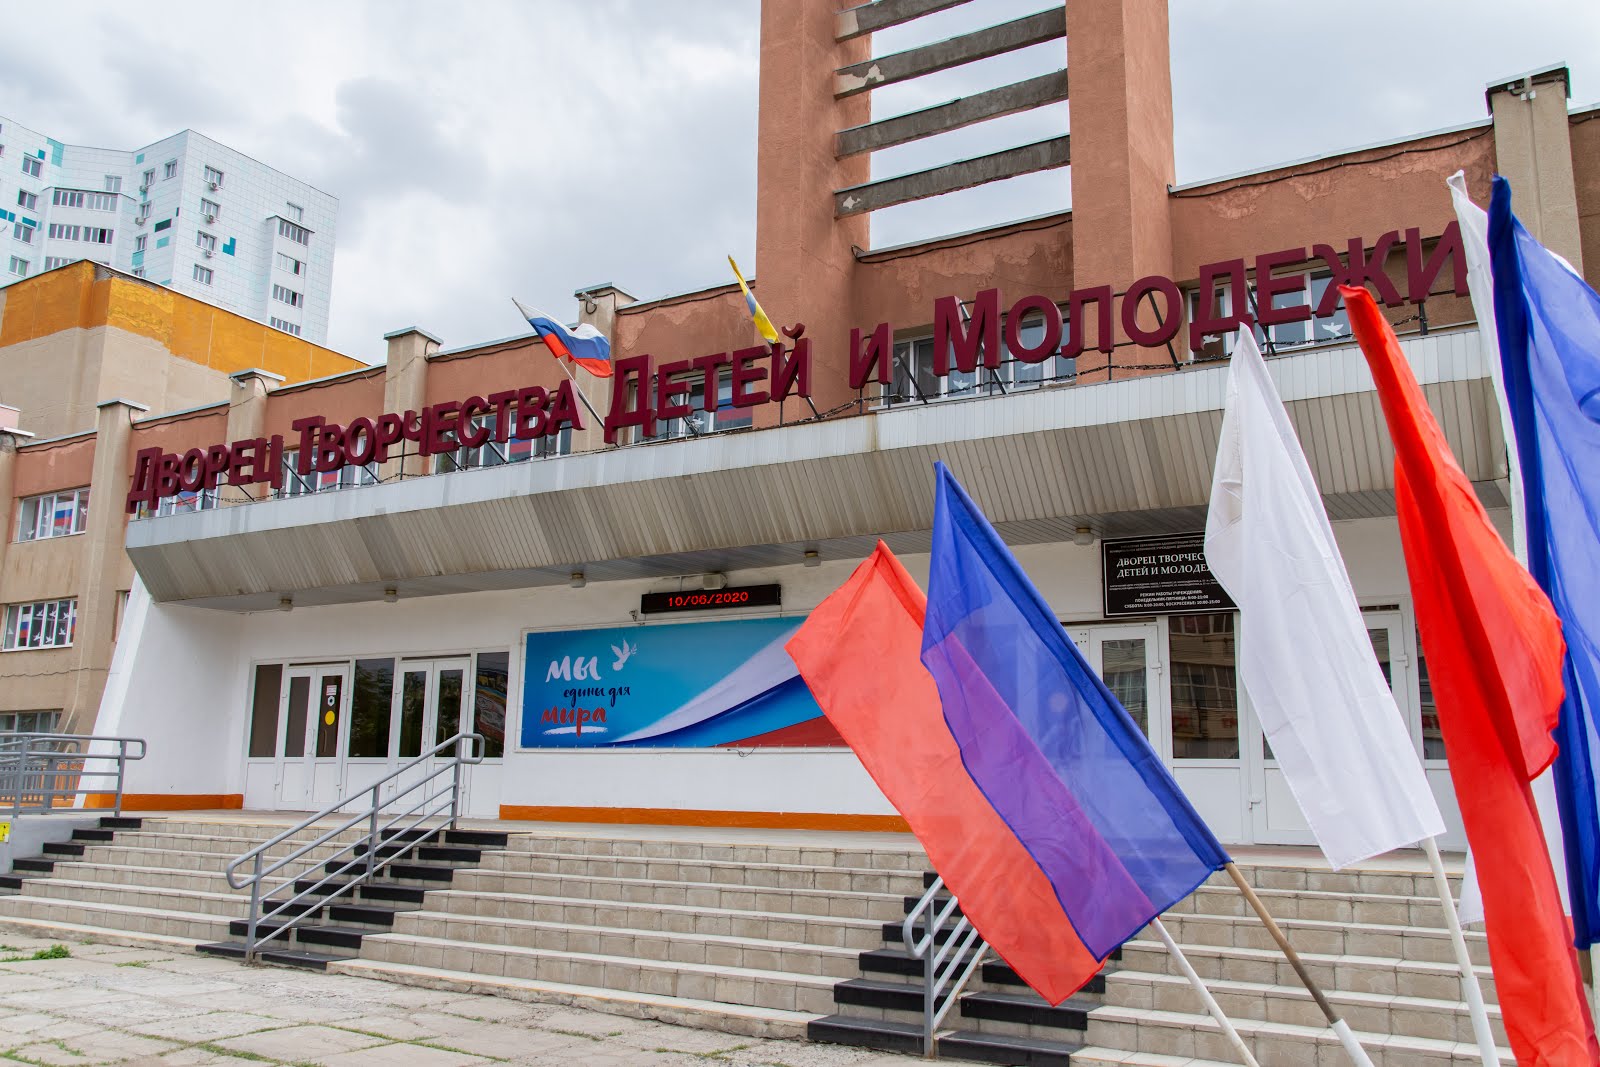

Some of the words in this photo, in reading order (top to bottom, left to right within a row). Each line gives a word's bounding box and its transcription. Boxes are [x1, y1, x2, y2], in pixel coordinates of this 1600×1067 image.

[126, 434, 284, 514] ДВОРЕЦ
[292, 378, 586, 476] ТВОРЧЕСТВА
[604, 323, 813, 444] ДЕТЕЙ
[850, 322, 894, 389] И
[1117, 555, 1157, 568] ДВОРЕЦ
[1158, 552, 1205, 564] ТВОРЧЕС
[1117, 565, 1149, 579] ДЕТЕЙ
[1151, 566, 1158, 575] И
[1160, 563, 1210, 575] МОЛОДЕ
[668, 591, 749, 607] 10/06/2020
[563, 686, 605, 708] едины
[608, 685, 631, 708] для
[540, 705, 608, 738] мира
